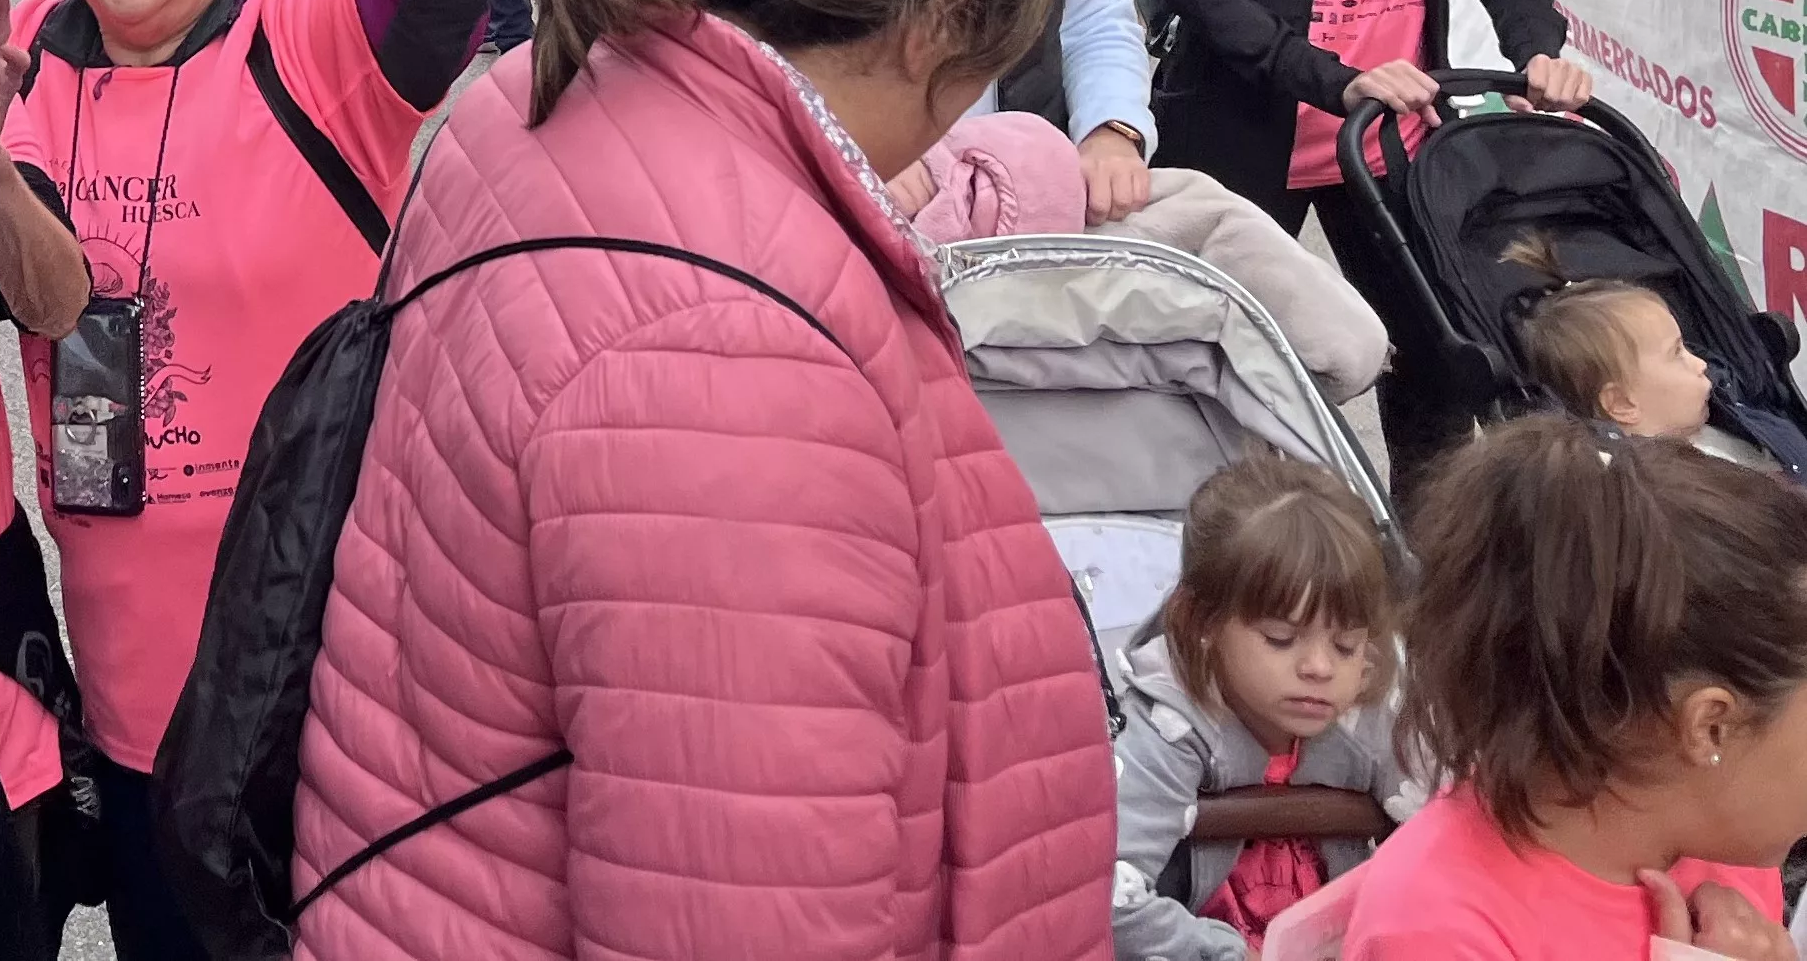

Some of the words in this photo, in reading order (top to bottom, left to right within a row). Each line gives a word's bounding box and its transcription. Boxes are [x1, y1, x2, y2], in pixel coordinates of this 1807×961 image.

[1742, 8, 1807, 45] CAB
[75, 170, 179, 203] CÁNCER
[122, 201, 202, 223] HUESCA
